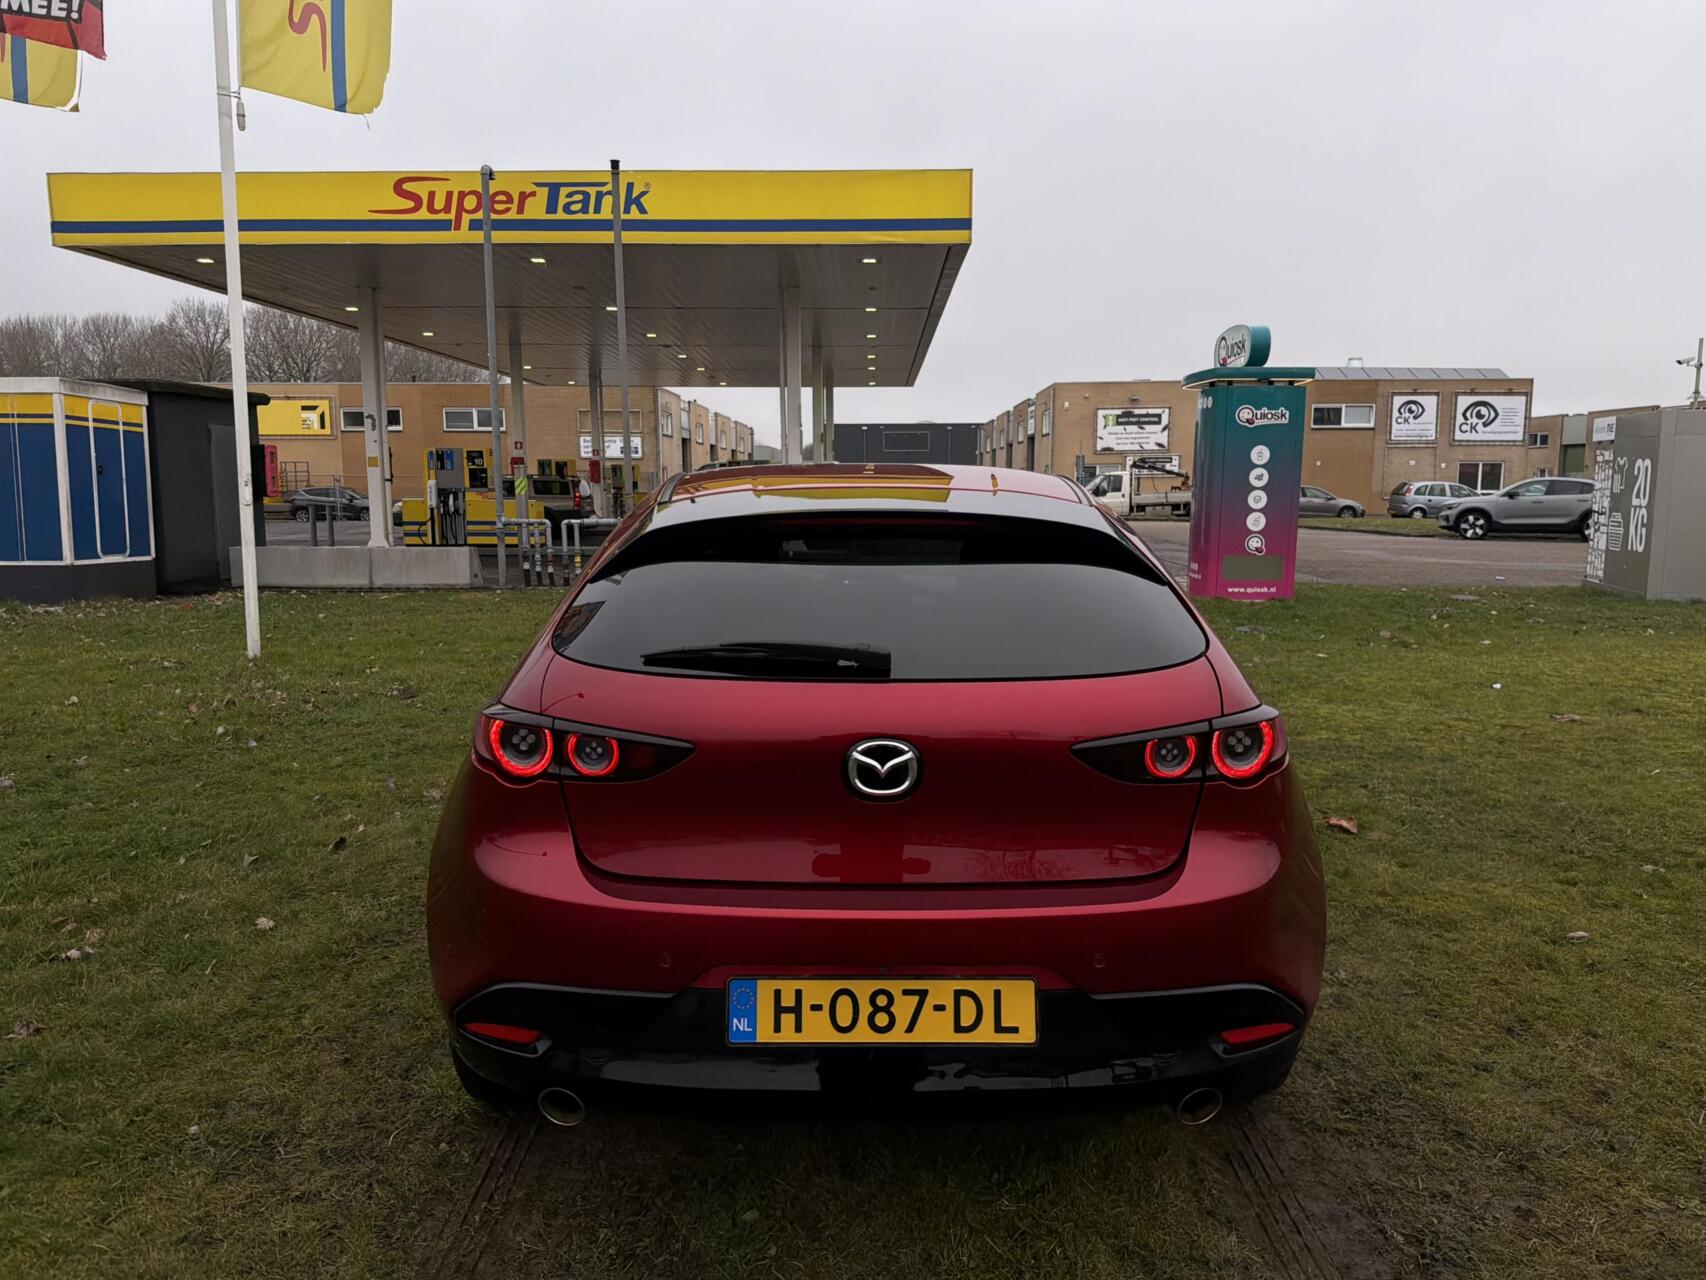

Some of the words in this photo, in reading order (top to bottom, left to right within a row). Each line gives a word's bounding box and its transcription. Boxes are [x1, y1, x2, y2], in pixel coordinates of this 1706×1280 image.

[1218, 333, 1247, 367] Quiosk
[1237, 406, 1288, 425] Quiosk
[1395, 416, 1411, 425] CK
[1459, 422, 1479, 434] CK
[1632, 458, 1652, 507] 20
[1628, 507, 1648, 553] KG
[732, 1018, 753, 1032] NL
[773, 988, 1020, 1034] H-087-DL
